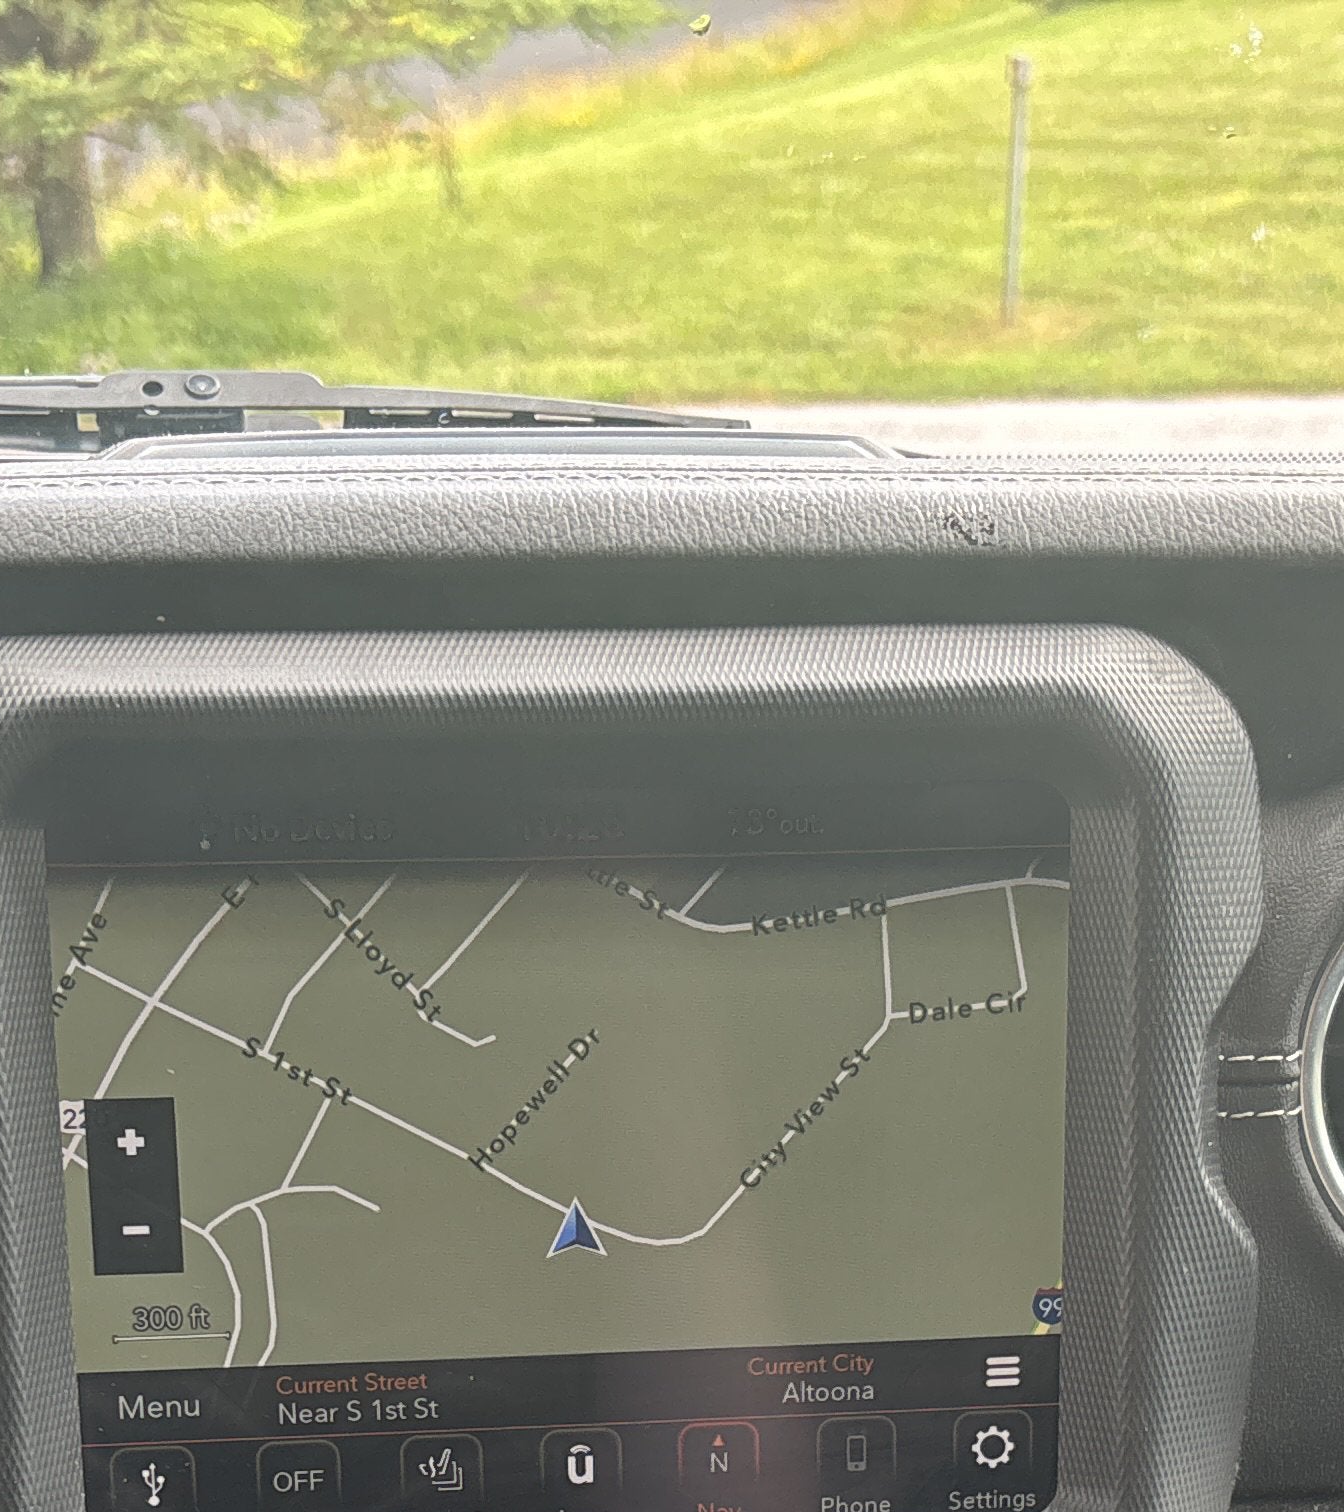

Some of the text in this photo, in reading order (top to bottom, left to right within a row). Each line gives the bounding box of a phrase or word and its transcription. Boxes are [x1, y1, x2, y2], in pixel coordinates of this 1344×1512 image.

[640, 890, 667, 920] St
[752, 896, 888, 936] Kettle Rd
[69, 913, 107, 966] Ave
[324, 899, 442, 1023] S Lloyd St
[909, 992, 1027, 1025] Dale Cir
[241, 1037, 353, 1107] S 1st St
[468, 1027, 603, 1173] Hopewell Dr
[739, 1046, 871, 1190] City View St
[132, 1304, 210, 1332] 300 ft
[748, 1352, 875, 1377] Current City
[275, 1373, 429, 1396] Current Street
[782, 1381, 875, 1405] Altoona
[117, 1394, 202, 1421] Menu
[278, 1397, 440, 1426] Near S 1st St
[709, 1452, 729, 1474] N
[273, 1469, 325, 1494] OFF
